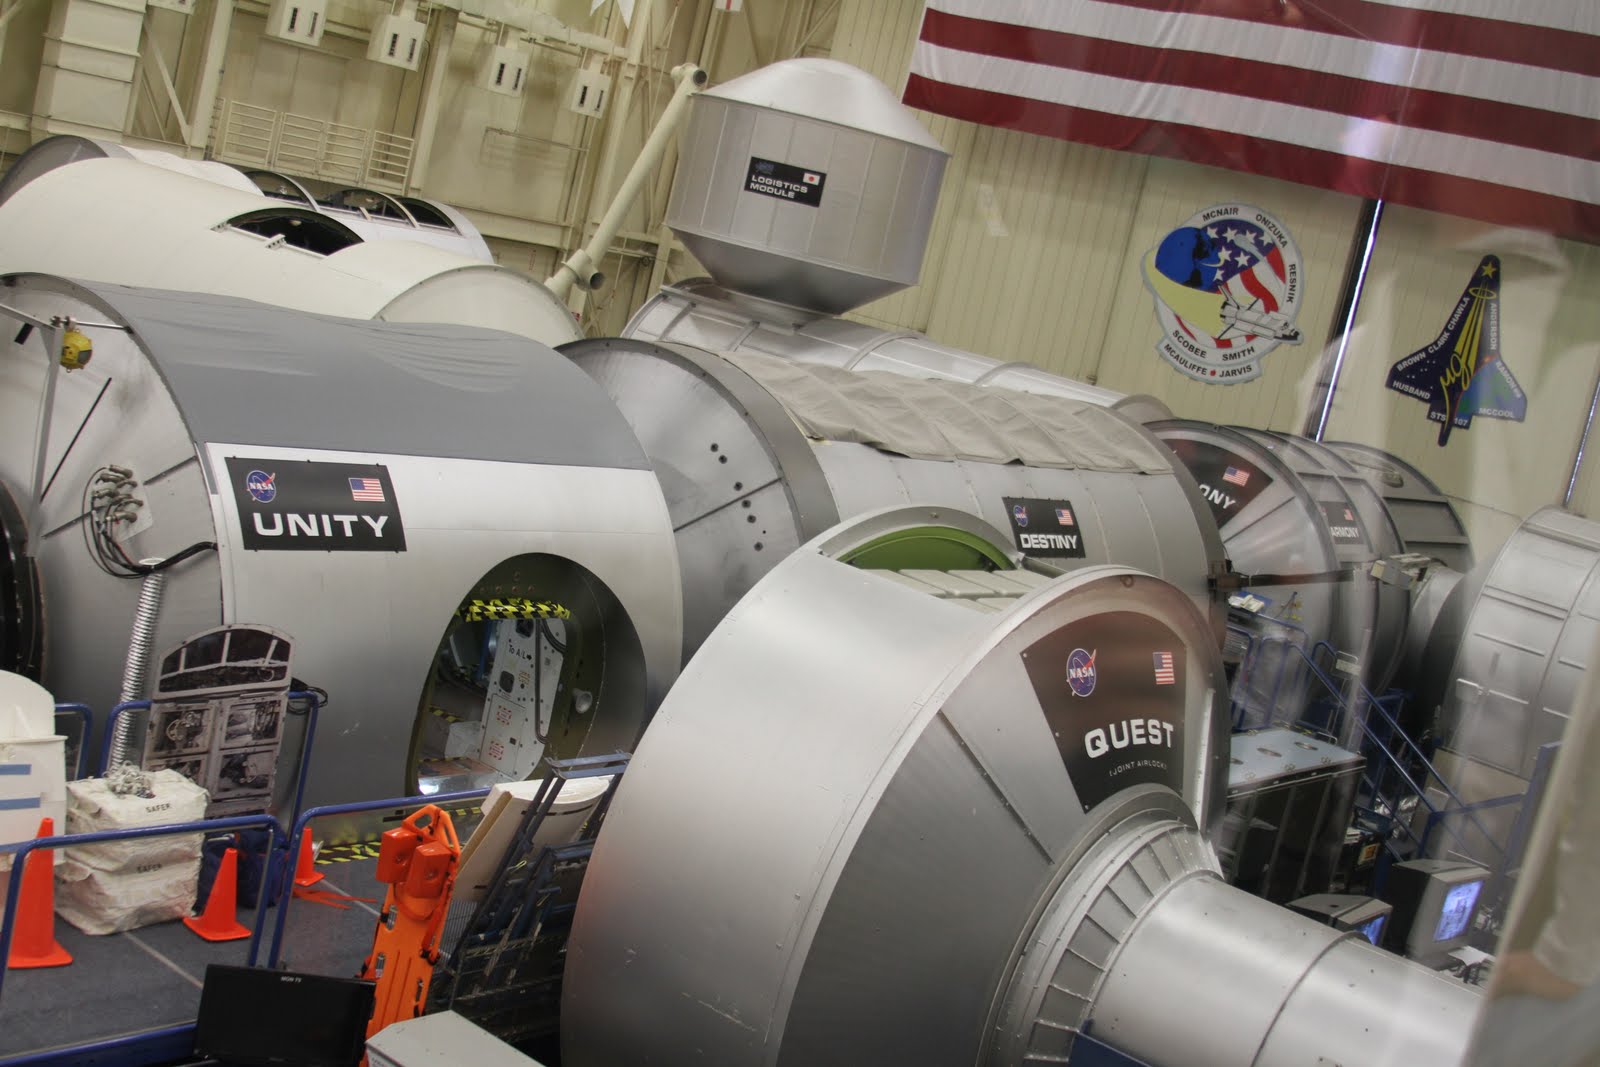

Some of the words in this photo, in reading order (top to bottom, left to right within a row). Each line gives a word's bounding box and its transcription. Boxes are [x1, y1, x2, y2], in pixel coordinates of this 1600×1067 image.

[749, 182, 796, 199] MODULE
[750, 175, 808, 194] LOGISTICS
[1202, 207, 1240, 222] MCNAIR
[1255, 213, 1288, 249] ONIZUKA
[1286, 263, 1297, 304] RESNIK
[1448, 297, 1470, 331] CHAWLA
[1489, 302, 1498, 350] ANDERSON
[1172, 329, 1208, 359] SCOBEE
[1427, 331, 1450, 354] CLARK
[1163, 343, 1208, 376] MCAULIFFE
[1219, 365, 1253, 378] JARVIS
[1222, 346, 1255, 361] SMITH
[1397, 351, 1427, 372] BROWN
[1392, 380, 1431, 400] HUSBAND
[1430, 411, 1446, 422] STS
[1478, 407, 1515, 419] MCCOOL
[249, 482, 274, 491] NASA
[253, 512, 388, 538] UNITY
[1330, 526, 1359, 538] ARMONY
[1019, 533, 1077, 549] DESTINY
[1069, 667, 1094, 679] NASA
[1084, 718, 1174, 759] QUEST
[145, 803, 170, 813] SAFER
